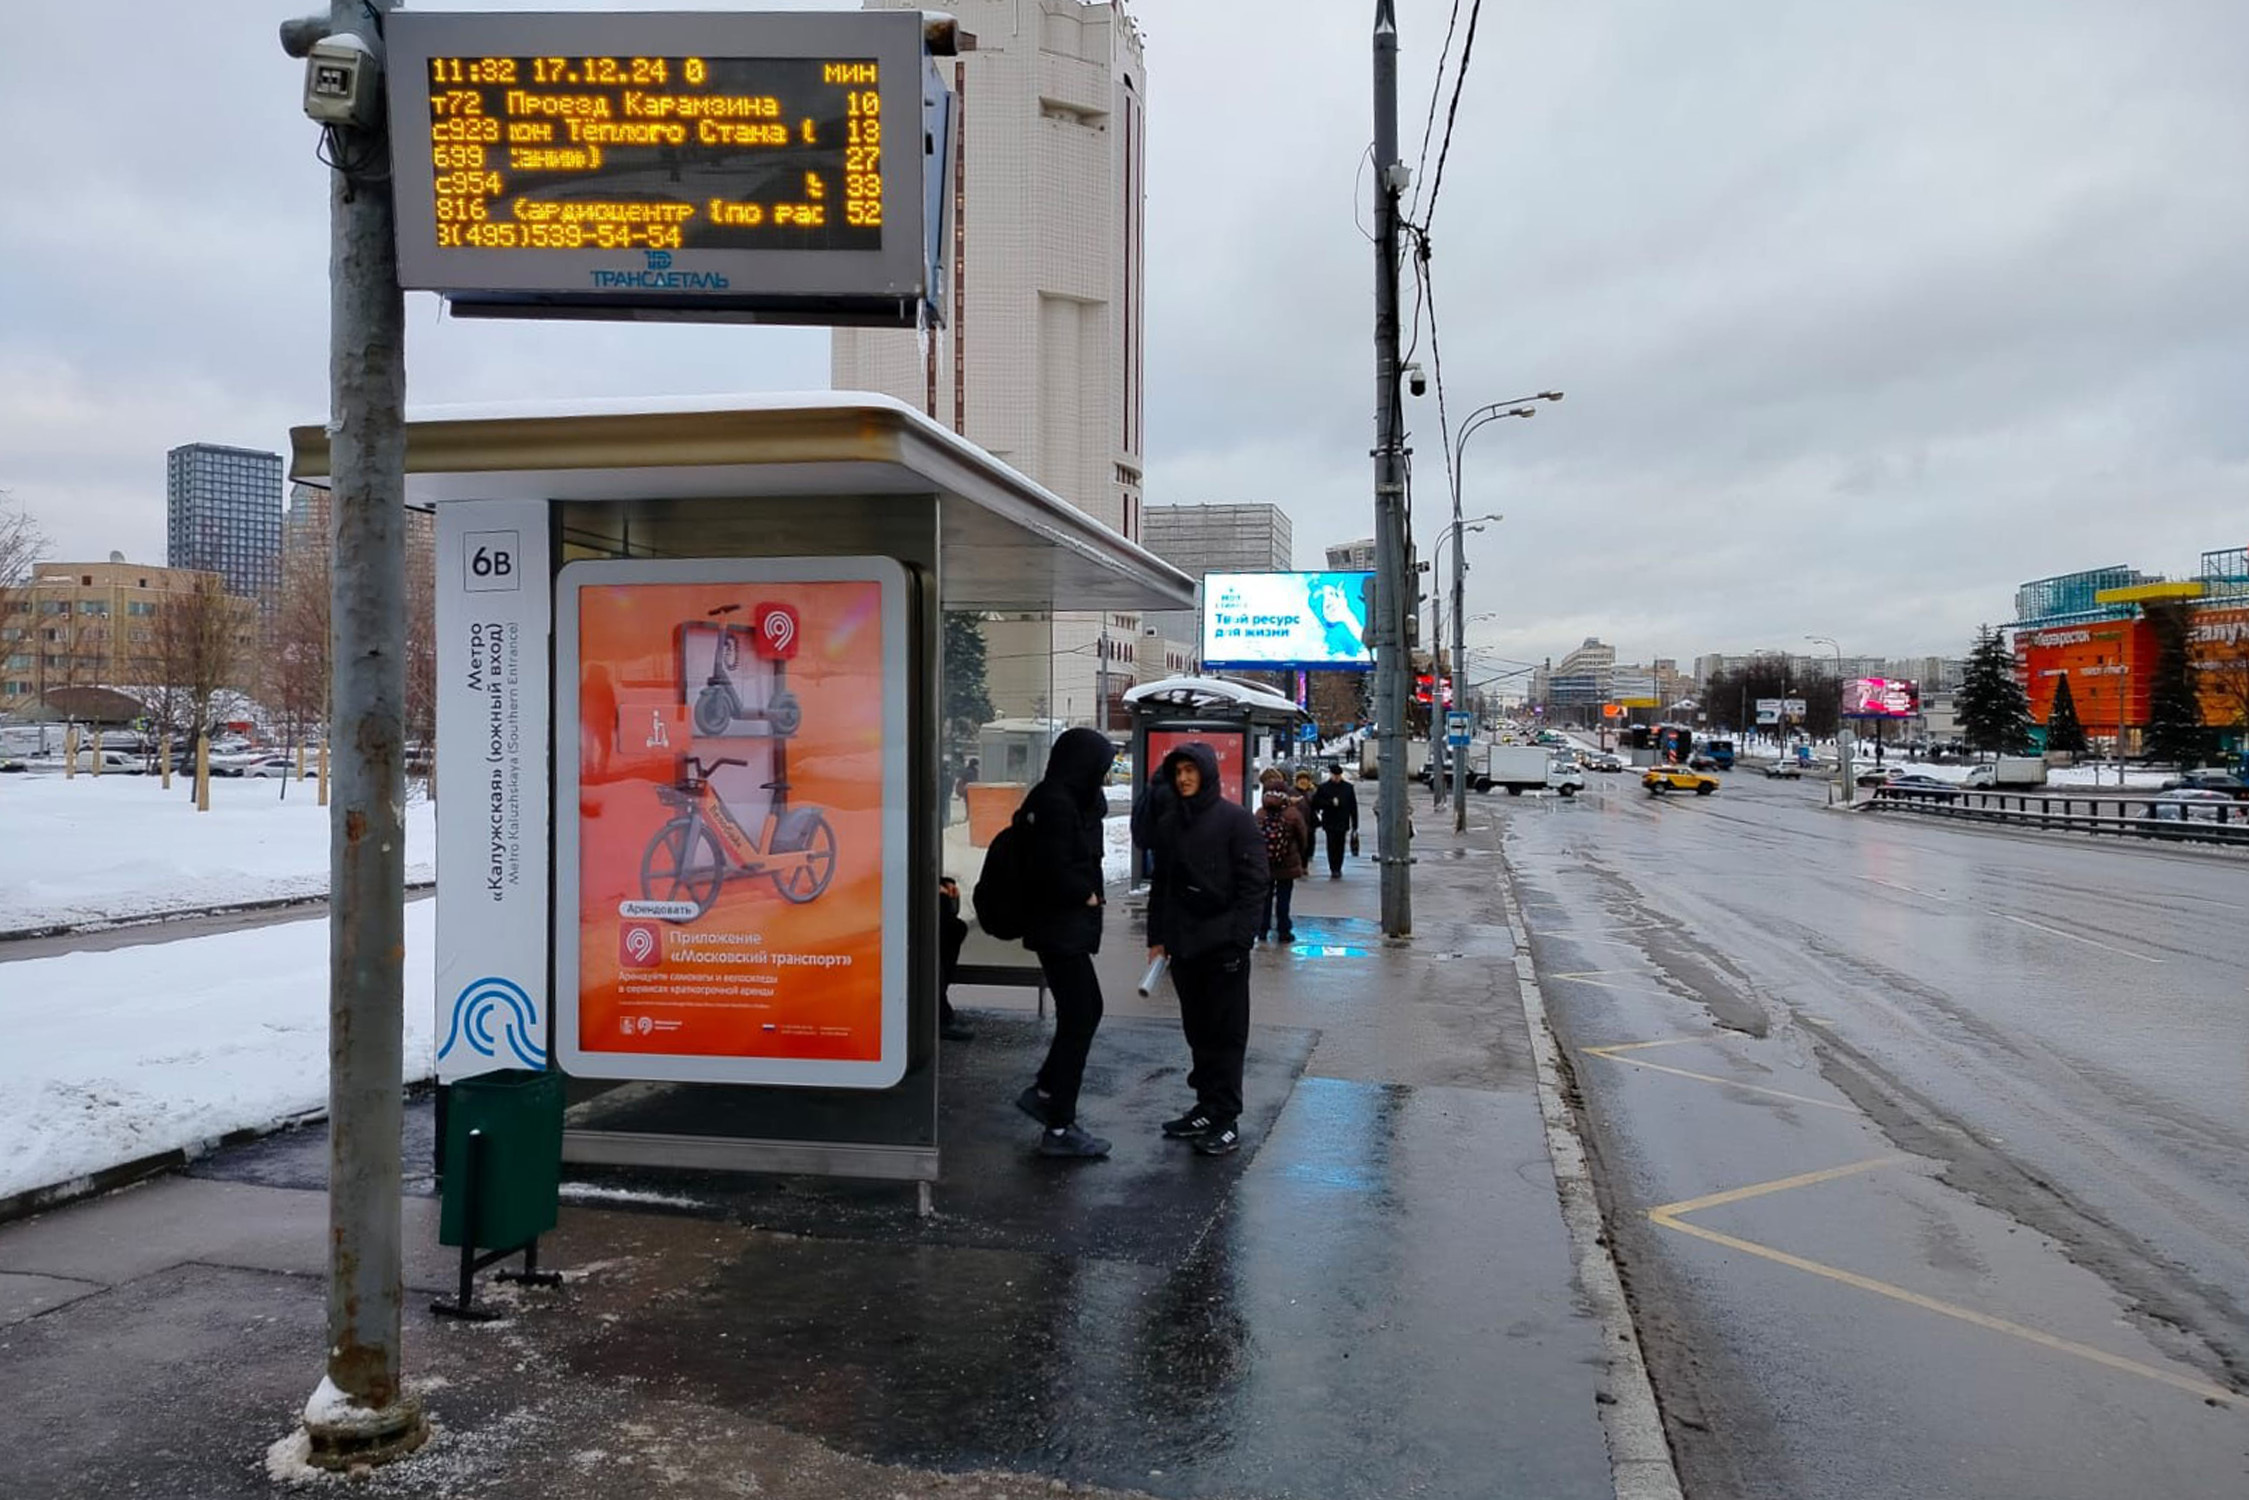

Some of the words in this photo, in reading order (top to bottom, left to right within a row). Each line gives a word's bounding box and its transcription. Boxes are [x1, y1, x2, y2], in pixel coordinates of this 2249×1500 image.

[433, 58, 517, 82] 11:32
[534, 58, 668, 83] 17.12.24
[431, 91, 482, 115] т72
[507, 91, 611, 117] Проезд
[625, 91, 780, 117] Карамзина
[847, 91, 880, 116] 10
[432, 118, 499, 141] с923
[565, 117, 685, 144] Тёплого
[700, 118, 788, 144] Стана
[847, 118, 880, 143] 13
[433, 145, 484, 168] 699
[846, 146, 881, 170] 27
[435, 171, 502, 195] с954
[846, 174, 881, 197] 33
[436, 198, 488, 221] 816
[846, 200, 882, 224] 52
[590, 270, 730, 289] ТРАНСДЕТАЛЬ
[1245, 628, 1290, 638] жизни
[1252, 615, 1300, 627] ресурс
[467, 623, 485, 691] Метро
[485, 623, 504, 676] вход)
[507, 622, 518, 684] Entrance)
[485, 683, 503, 763] (южный
[507, 688, 519, 755] (Southern
[508, 757, 521, 840] Kaluzhskaya
[487, 769, 507, 902] «Калужская»
[508, 843, 519, 885] Metro
[626, 903, 693, 917] Арендовать
[669, 930, 763, 946] Приложение
[671, 950, 768, 965] «Московский
[772, 953, 852, 968] транспорт»
